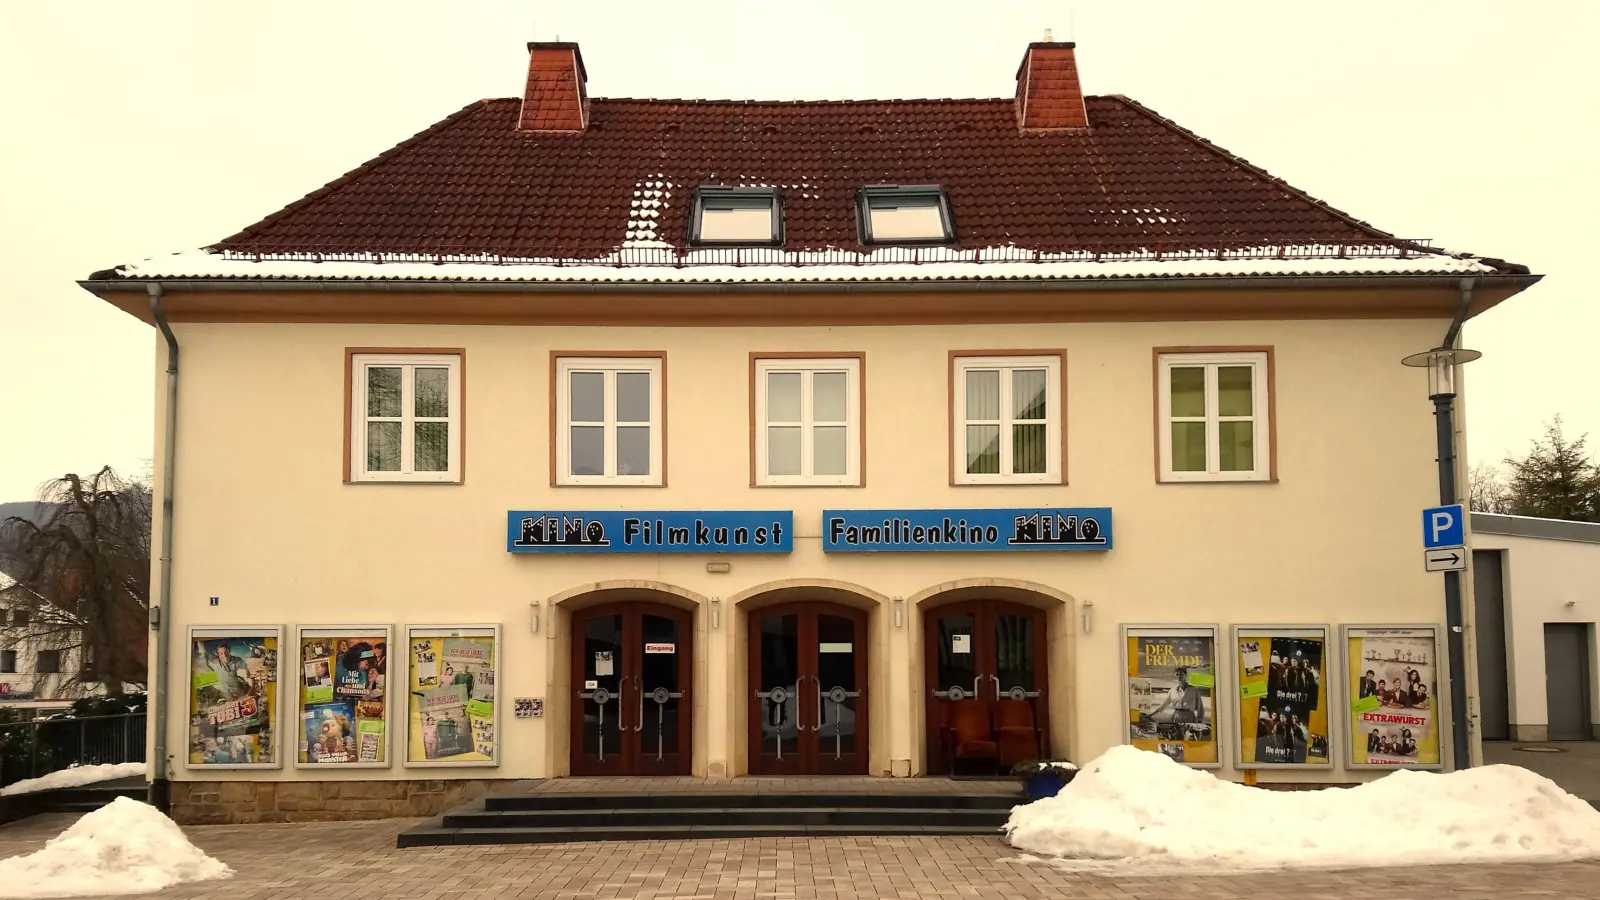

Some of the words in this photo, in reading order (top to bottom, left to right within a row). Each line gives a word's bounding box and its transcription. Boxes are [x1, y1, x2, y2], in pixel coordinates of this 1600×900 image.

[517, 513, 607, 545] KINO
[624, 518, 783, 546] Filmkunst
[829, 517, 999, 545] Familienkino
[1012, 511, 1103, 543] KINO
[1432, 512, 1454, 542] P
[1145, 644, 1174, 656] DER
[1145, 655, 1204, 667] FREMDE
[341, 676, 360, 684] Liebe
[348, 670, 359, 678] Mit
[336, 686, 370, 695] Chansons
[1276, 690, 1286, 698] Die
[1286, 691, 1297, 699] drei
[208, 706, 241, 725] TOBI
[1363, 712, 1426, 725] EXTRAWURST
[1265, 745, 1275, 754] Die
[1275, 747, 1286, 755] drei
